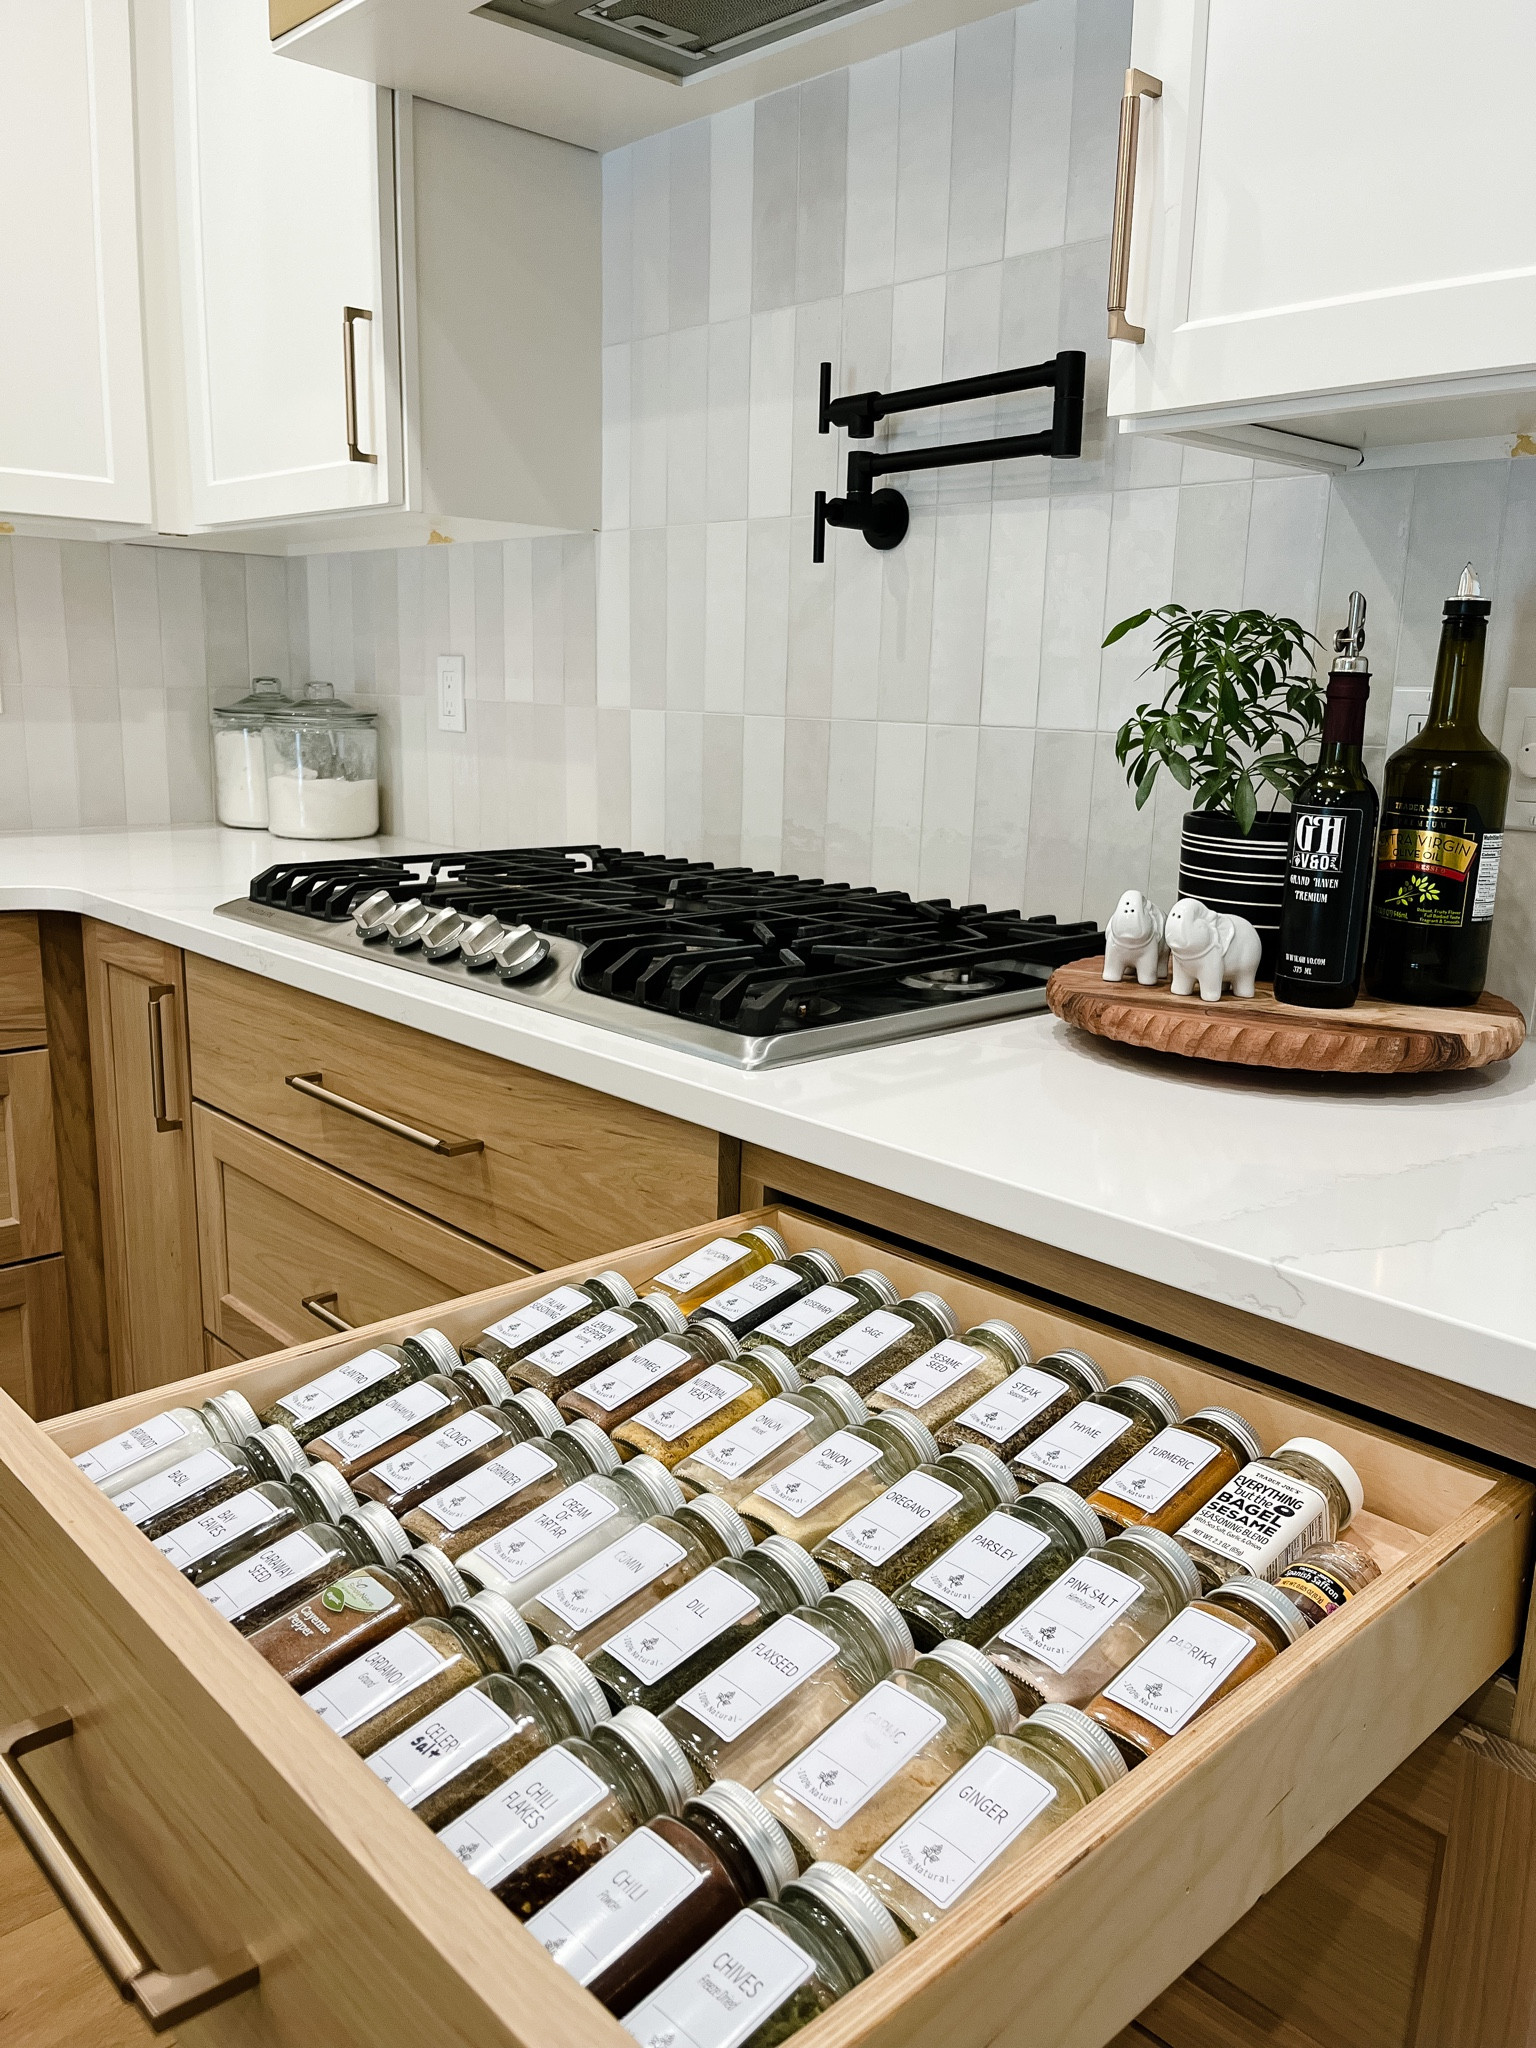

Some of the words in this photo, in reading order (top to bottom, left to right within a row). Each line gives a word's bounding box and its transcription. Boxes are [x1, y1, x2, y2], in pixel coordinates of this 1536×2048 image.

[1395, 801, 1425, 812] TRADER
[1427, 805, 1454, 814] JOE'S
[1392, 848, 1420, 859] OLIVE
[1423, 851, 1440, 862] OIL
[1418, 834, 1471, 856] VIRGIN
[1301, 852, 1330, 870] V&O
[1289, 874, 1311, 886] GRAND
[1313, 877, 1339, 889] HAVEN
[749, 1281, 768, 1292] SEED
[756, 1274, 779, 1287] POPPY
[802, 1298, 833, 1316] ROSEMARY
[590, 1320, 616, 1334] LEMON
[861, 1326, 884, 1339] SAGE
[631, 1354, 661, 1373] NUTMEG
[926, 1360, 948, 1373] SEED
[930, 1352, 963, 1370] SESAME
[688, 1386, 713, 1402] YEAST
[1011, 1382, 1042, 1398] STEAK
[755, 1414, 782, 1432] ONION
[1069, 1420, 1102, 1439] THYME
[443, 1427, 472, 1447] CLOVES
[821, 1448, 852, 1467] ONION
[1148, 1446, 1195, 1470] TURMERIC
[168, 1469, 191, 1487] BASIL
[1256, 1472, 1281, 1487] TRADER
[1281, 1484, 1301, 1495] JOE'S
[1233, 1474, 1305, 1511] EVERYTHING
[1234, 1485, 1254, 1501] but
[1252, 1492, 1274, 1509] the
[562, 1498, 593, 1520] CREAM
[886, 1491, 931, 1519] OREGANO
[1216, 1491, 1282, 1528] BAGEL
[217, 1509, 238, 1523] BAY
[534, 1513, 567, 1539] TARTAR
[555, 1510, 573, 1522] OF
[1207, 1501, 1278, 1538] SESAME
[197, 1517, 227, 1537] LEAVES
[1192, 1528, 1204, 1536] NET
[1212, 1538, 1223, 1546] 2.3
[1199, 1509, 1244, 1533] SEASONING
[1242, 1528, 1270, 1545] BLEND
[1206, 1520, 1216, 1529] Sea
[1226, 1531, 1241, 1541] Garlic
[1245, 1539, 1262, 1551] Onion
[971, 1534, 1018, 1561] PARSLEY
[259, 1550, 295, 1579] CARAWAY
[614, 1550, 646, 1574] CUMIN
[248, 1564, 272, 1583] SEED
[1064, 1577, 1091, 1595] PINK
[1088, 1588, 1119, 1609] SALT
[1284, 1570, 1312, 1580] Spanish
[1311, 1575, 1339, 1600] Saffron
[686, 1598, 710, 1619] DILL
[287, 1612, 315, 1637] Pepper
[300, 1605, 331, 1635] Cayenne
[751, 1642, 799, 1678] FLAXSEED
[525, 1781, 559, 1811] CHILI
[958, 1785, 1009, 1825] GINGER
[502, 1790, 545, 1830] FLAKES
[612, 1869, 649, 1903] CHILI
[712, 1952, 764, 1998] CHIVES
